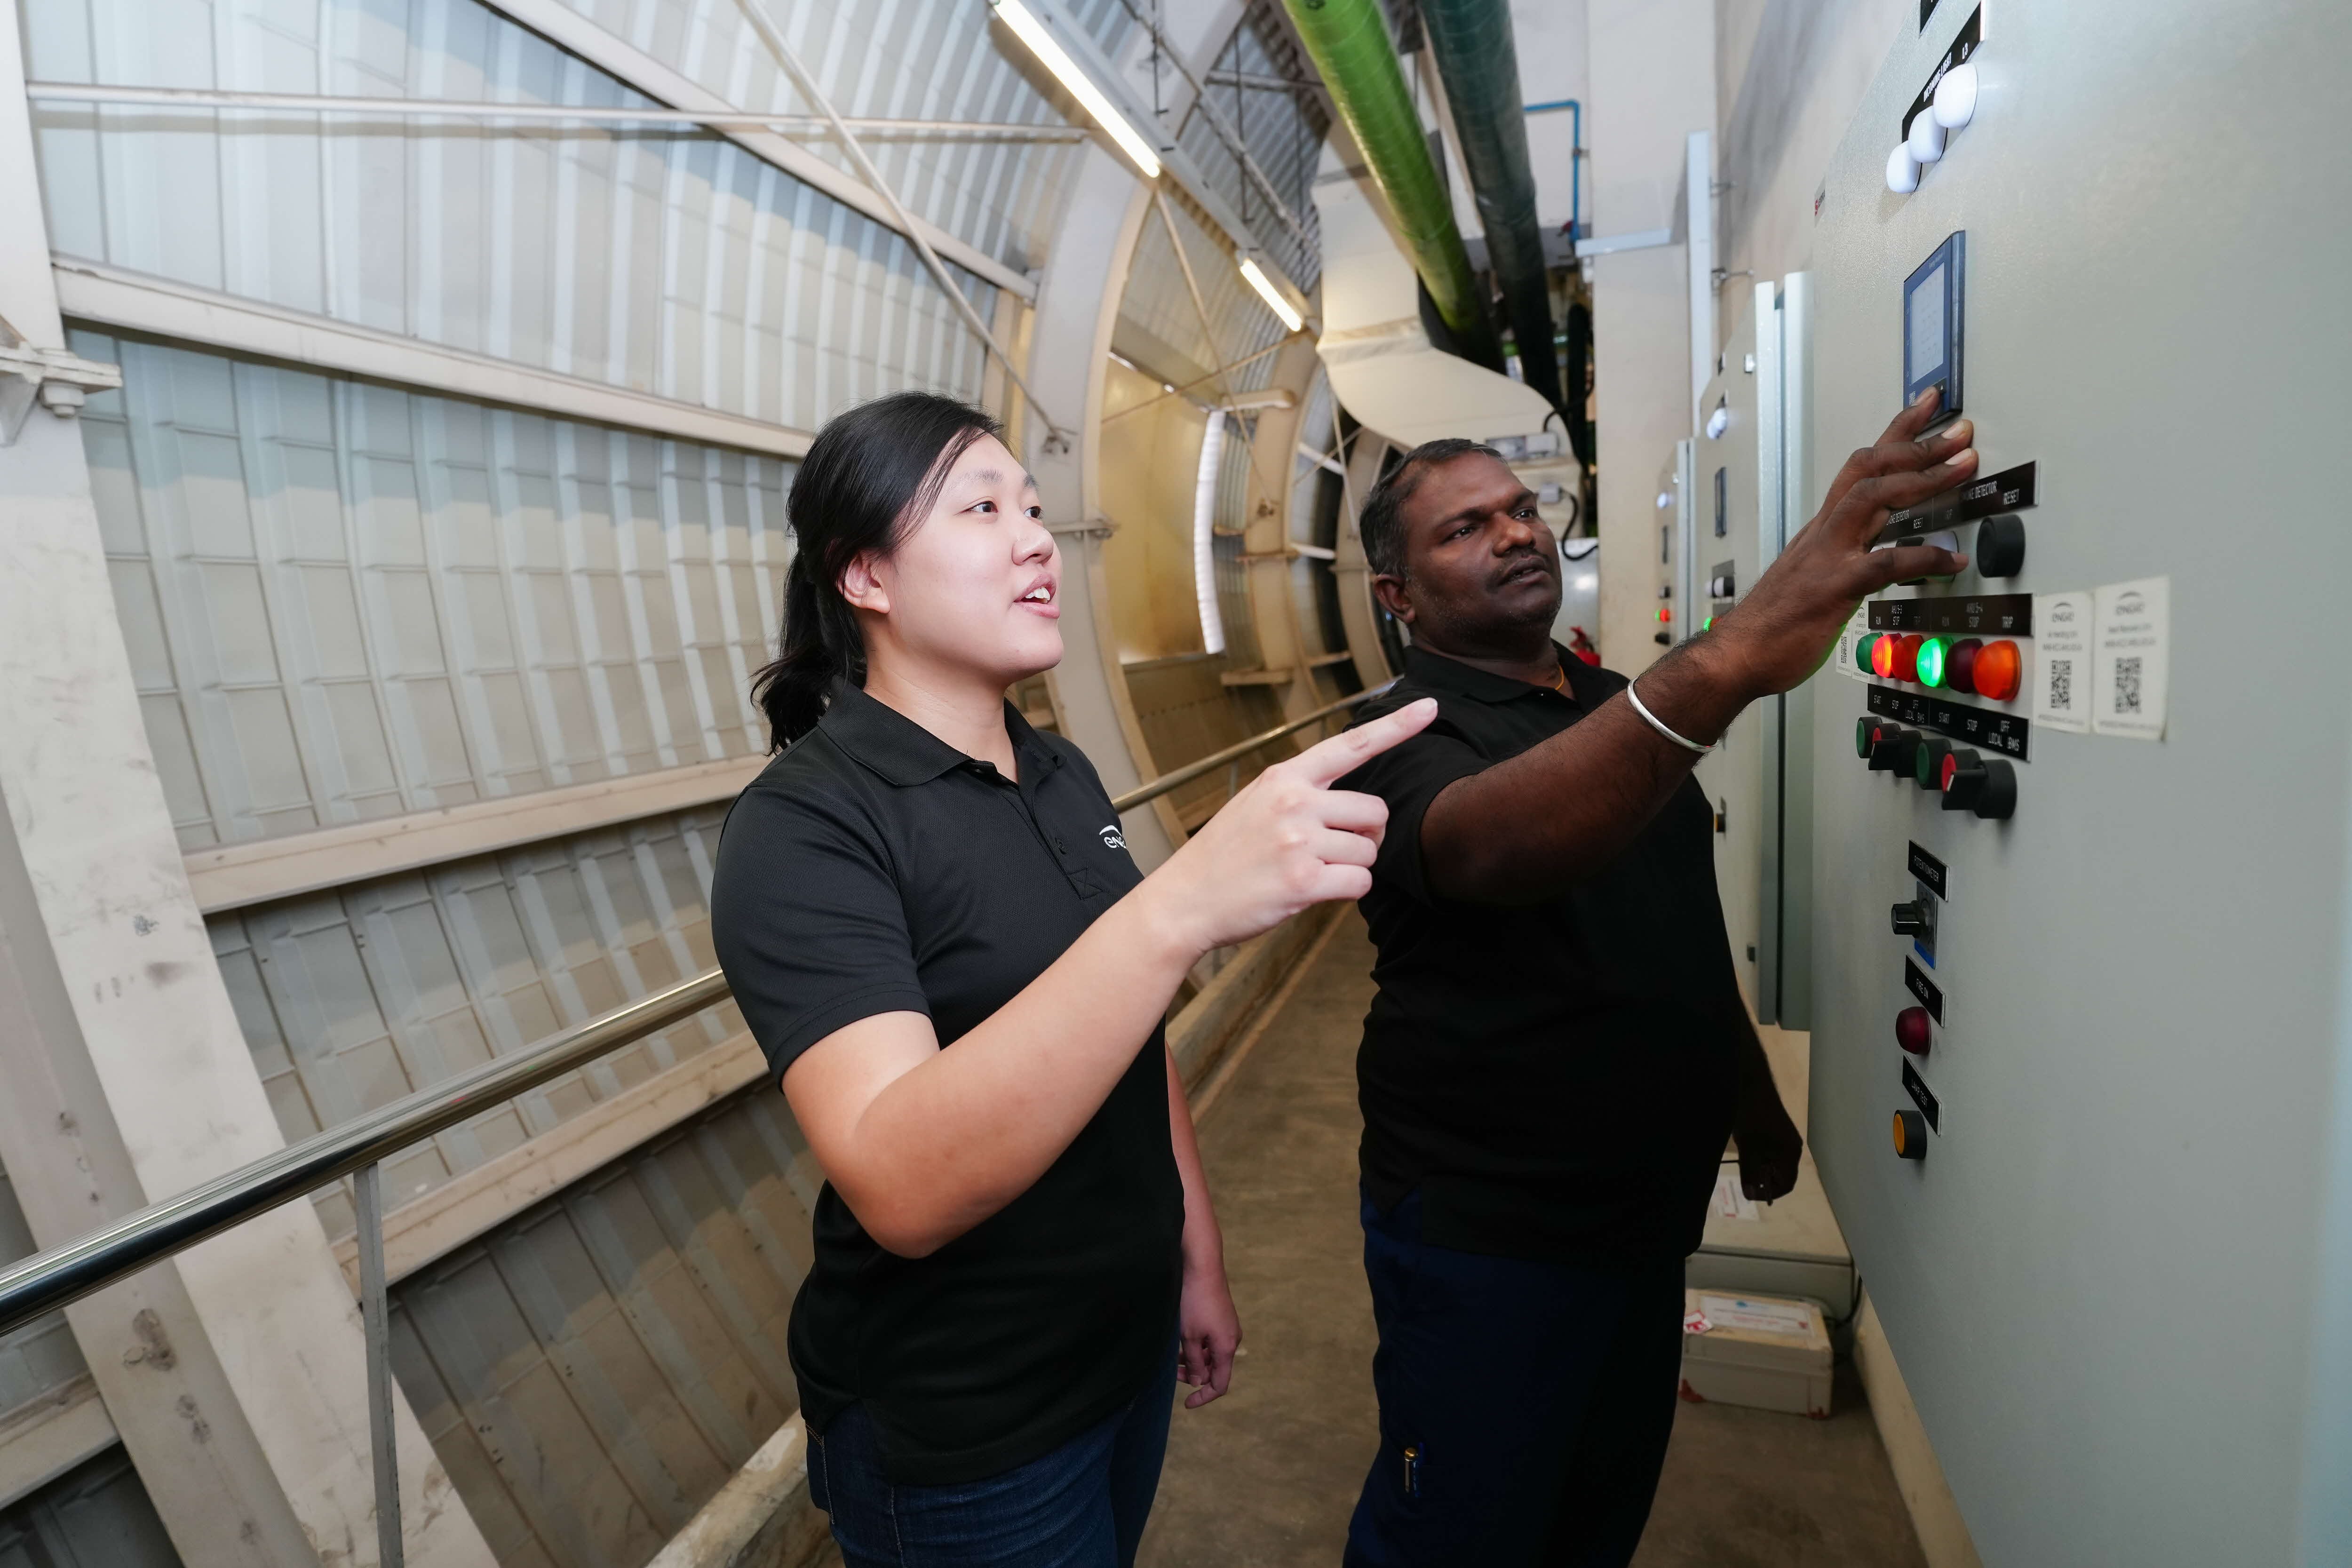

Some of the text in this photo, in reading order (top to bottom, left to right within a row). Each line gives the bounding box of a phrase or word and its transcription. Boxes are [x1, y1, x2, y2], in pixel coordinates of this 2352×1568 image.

[1962, 42, 1968, 59] L3
[1975, 481, 1997, 498] DETECTOR
[2003, 488, 2019, 505] RESET
[2002, 616, 2013, 629] TRIP
[1939, 712, 1978, 731] START STOP
[2001, 720, 2010, 732] OFF
[1988, 732, 2020, 751] LOCAL BMS
